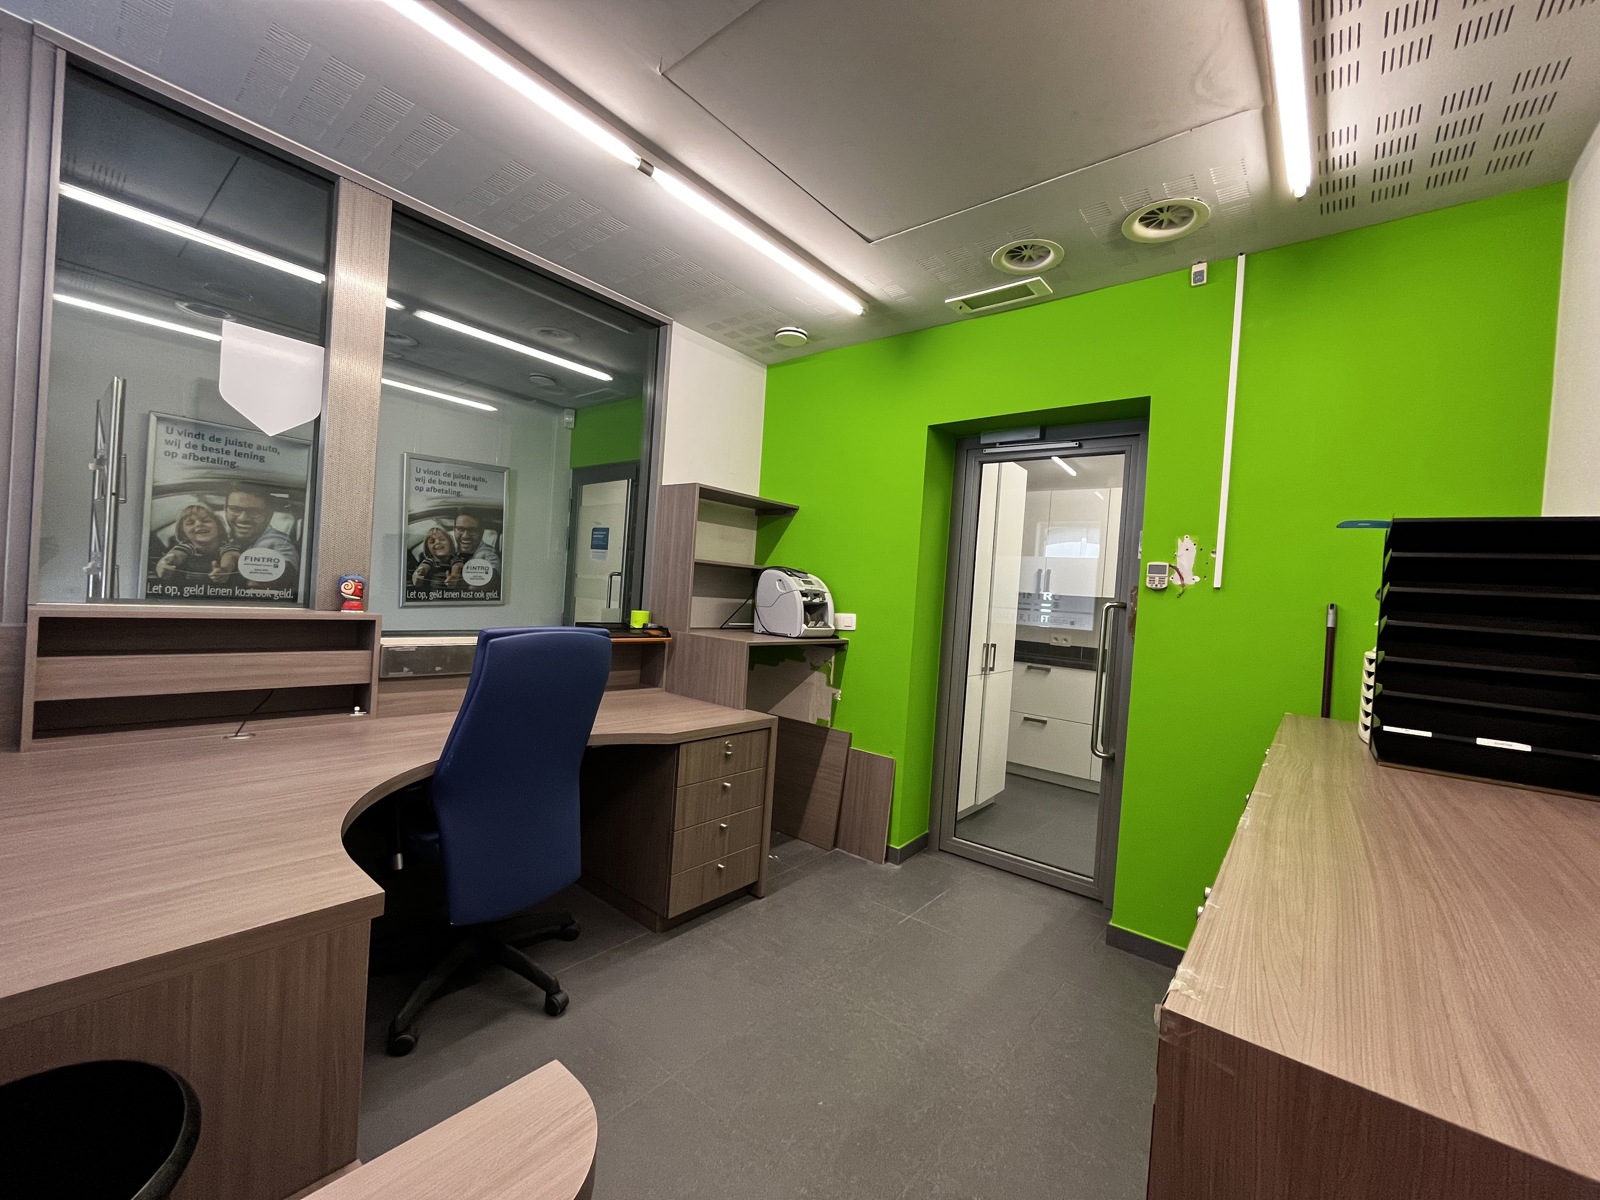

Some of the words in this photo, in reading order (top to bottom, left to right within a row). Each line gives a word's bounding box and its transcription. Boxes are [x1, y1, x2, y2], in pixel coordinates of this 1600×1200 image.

[165, 426, 174, 435] U
[177, 428, 205, 441] vindt
[208, 434, 222, 444] de
[224, 436, 254, 449] juiste
[256, 444, 281, 455] auto,
[164, 438, 181, 449] wij
[184, 441, 199, 451] de
[201, 443, 231, 456] beste
[234, 450, 266, 463] lening
[164, 450, 178, 459] op
[182, 453, 240, 469] afbetaling.
[415, 476, 426, 484] wij
[428, 477, 436, 485] de
[438, 478, 457, 487] beste
[458, 481, 478, 491] lening
[423, 468, 441, 476] vindt
[452, 472, 471, 480] juiste
[471, 475, 488, 484] auto,
[426, 486, 463, 497] afbetaling.
[244, 556, 280, 564] FINTRO
[147, 583, 162, 594] Let
[165, 585, 180, 596] op,
[183, 584, 205, 597] geld
[207, 585, 233, 596] lenen
[235, 586, 253, 597] kost
[273, 589, 294, 599] geld.
[406, 589, 416, 599] Let
[417, 591, 428, 600] op,
[429, 590, 442, 600] geld
[443, 590, 460, 599] lenen
[461, 590, 473, 599] kost
[474, 590, 485, 598] ook
[485, 590, 499, 601] geld.
